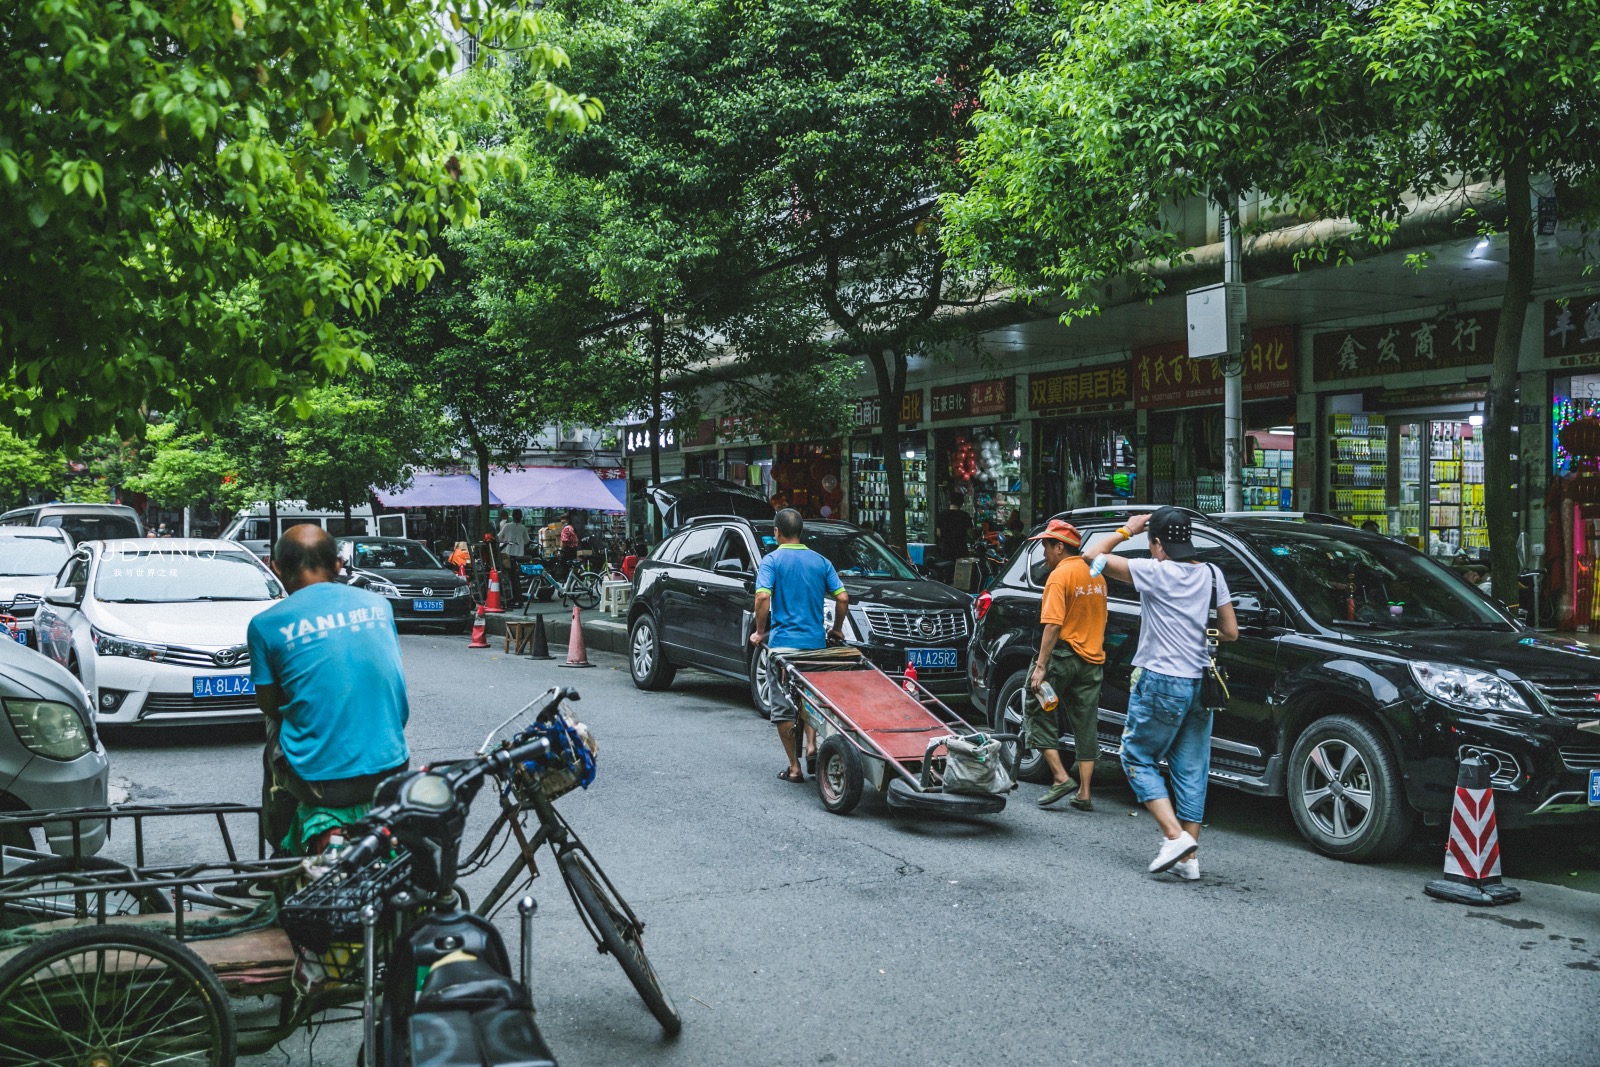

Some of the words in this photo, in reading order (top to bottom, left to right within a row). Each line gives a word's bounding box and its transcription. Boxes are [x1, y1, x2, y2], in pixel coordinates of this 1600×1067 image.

[1336, 317, 1483, 372] 鑫发商行
[1031, 367, 1128, 406] 双翼雨具百货
[848, 398, 881, 426] 日商行
[279, 611, 347, 644] YANI
[196, 677, 256, 695] 鄂A·8LA2
